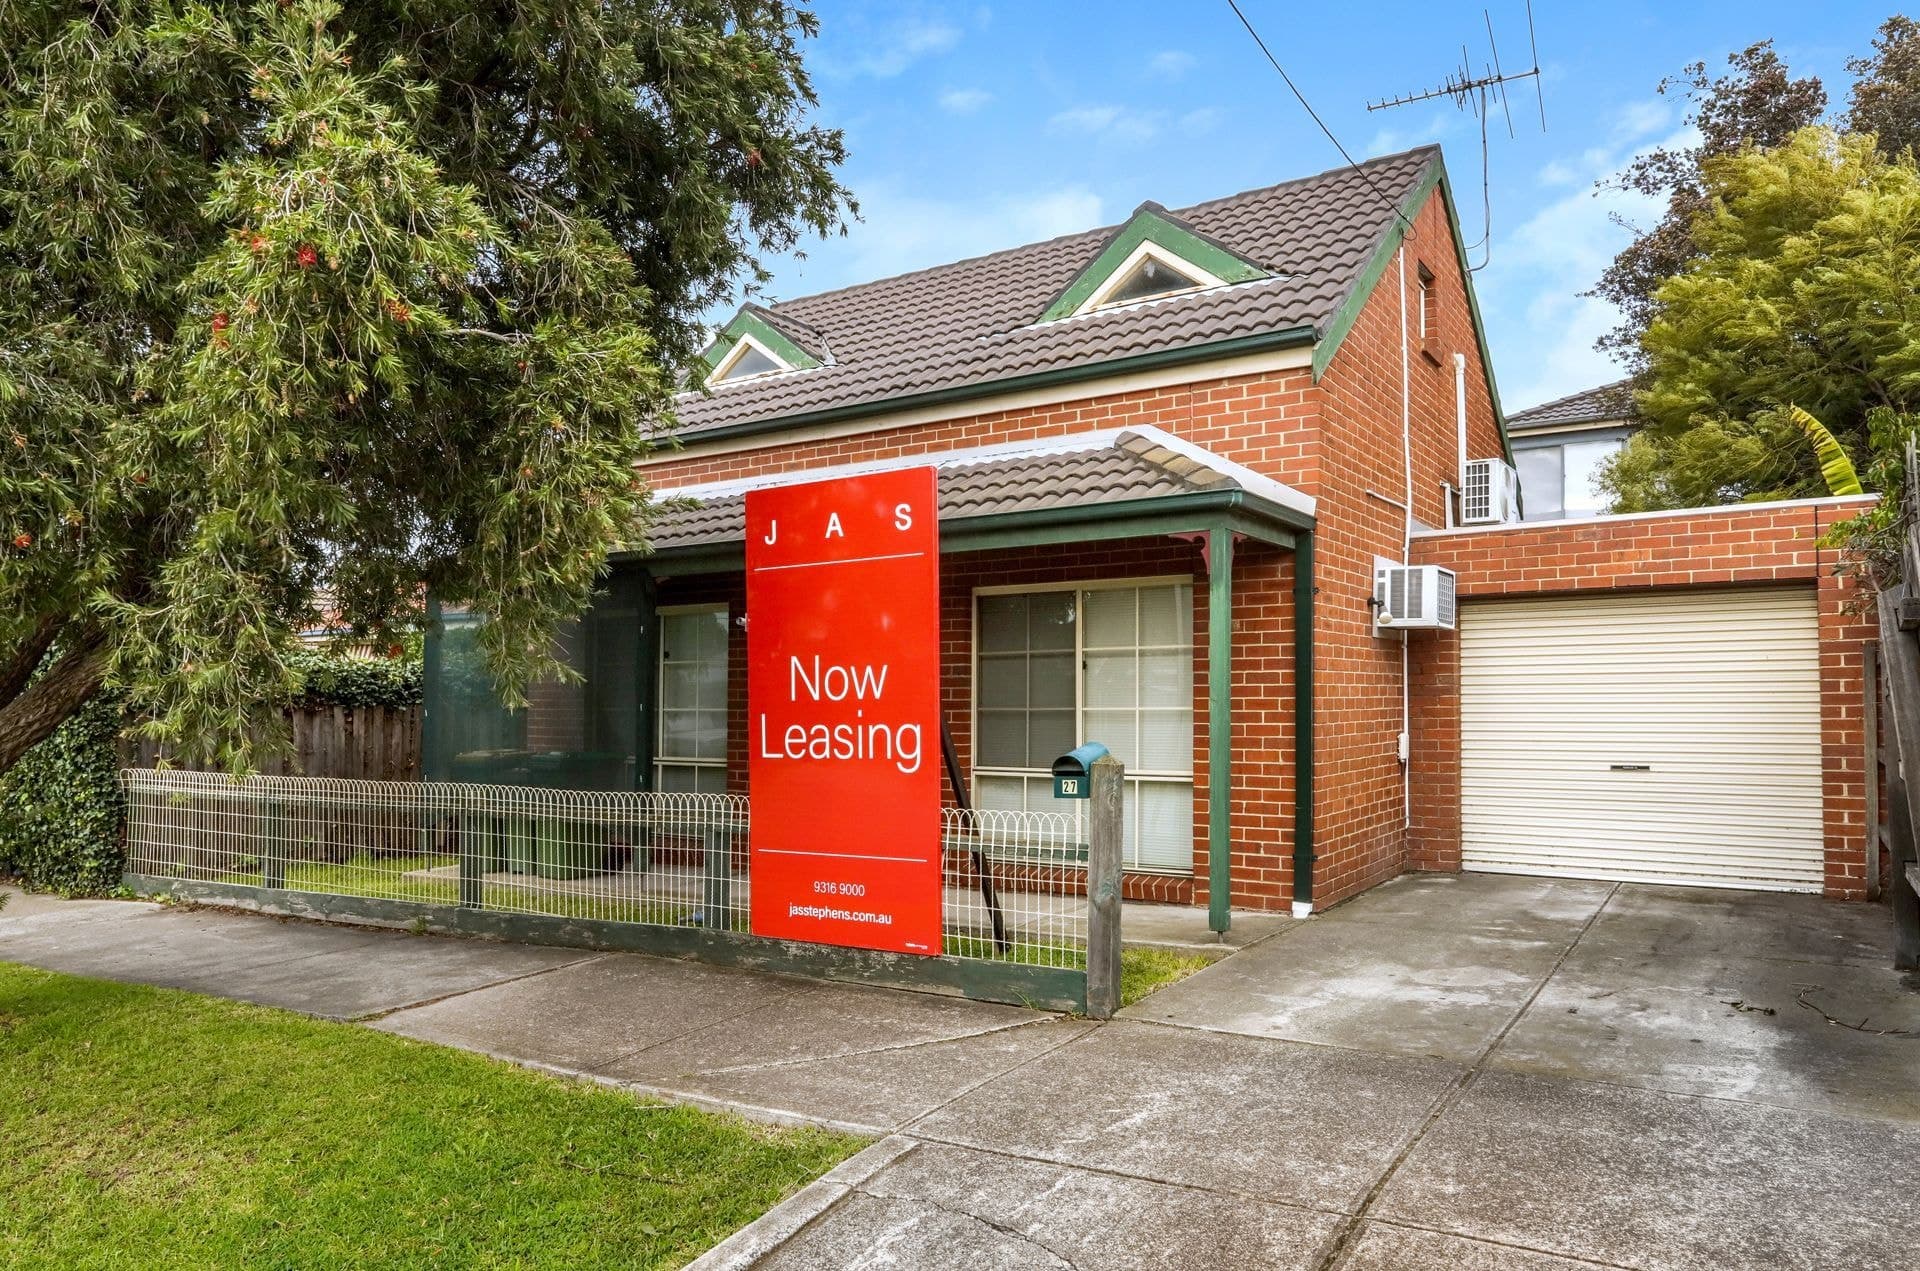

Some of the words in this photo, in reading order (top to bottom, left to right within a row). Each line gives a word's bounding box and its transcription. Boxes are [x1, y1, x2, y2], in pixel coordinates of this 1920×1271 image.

[790, 655, 888, 702] Now
[761, 709, 922, 774] Leasing
[1063, 780, 1077, 793] 27
[813, 880, 837, 895] 9316
[839, 882, 866, 897] 9000
[789, 902, 893, 925] jasstephens.com.au
